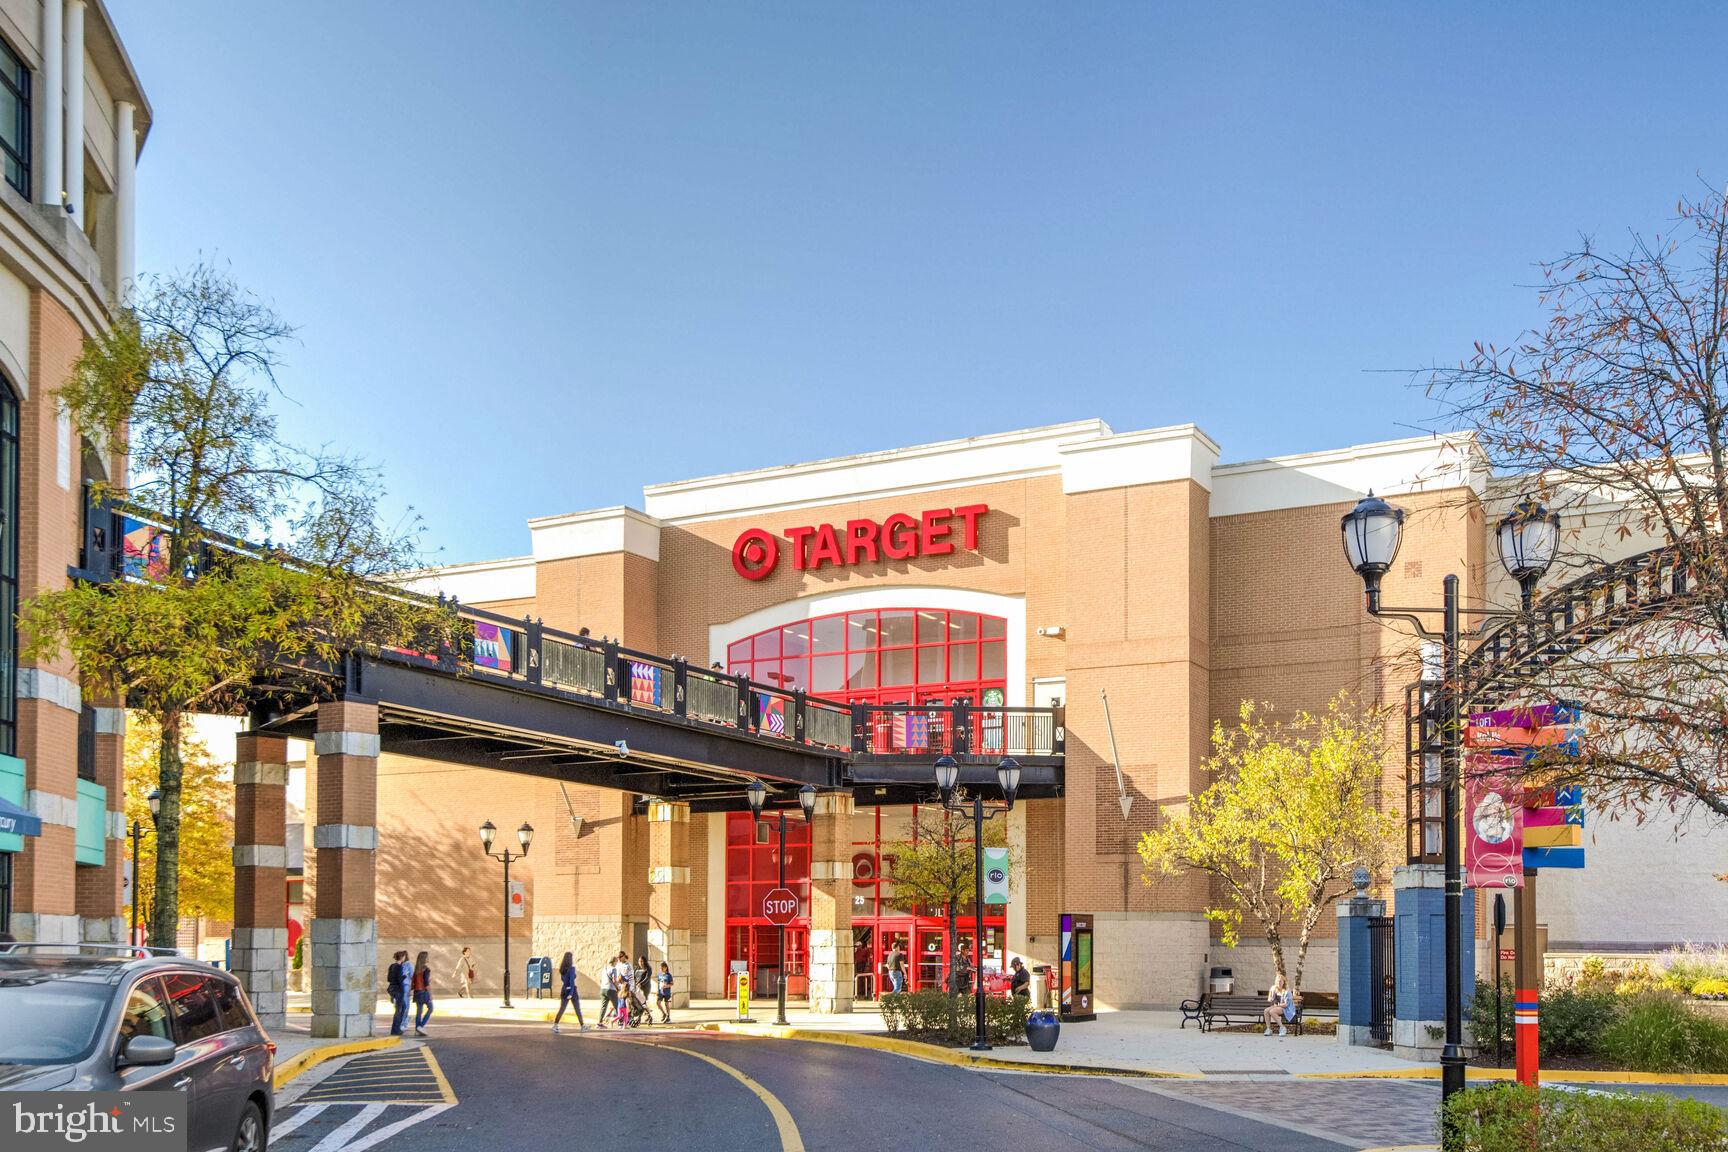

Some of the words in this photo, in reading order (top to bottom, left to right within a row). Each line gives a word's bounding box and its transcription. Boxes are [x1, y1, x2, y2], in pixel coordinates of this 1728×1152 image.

[784, 504, 988, 570] TARGET
[766, 900, 796, 914] STOP
[854, 896, 865, 905] 25
